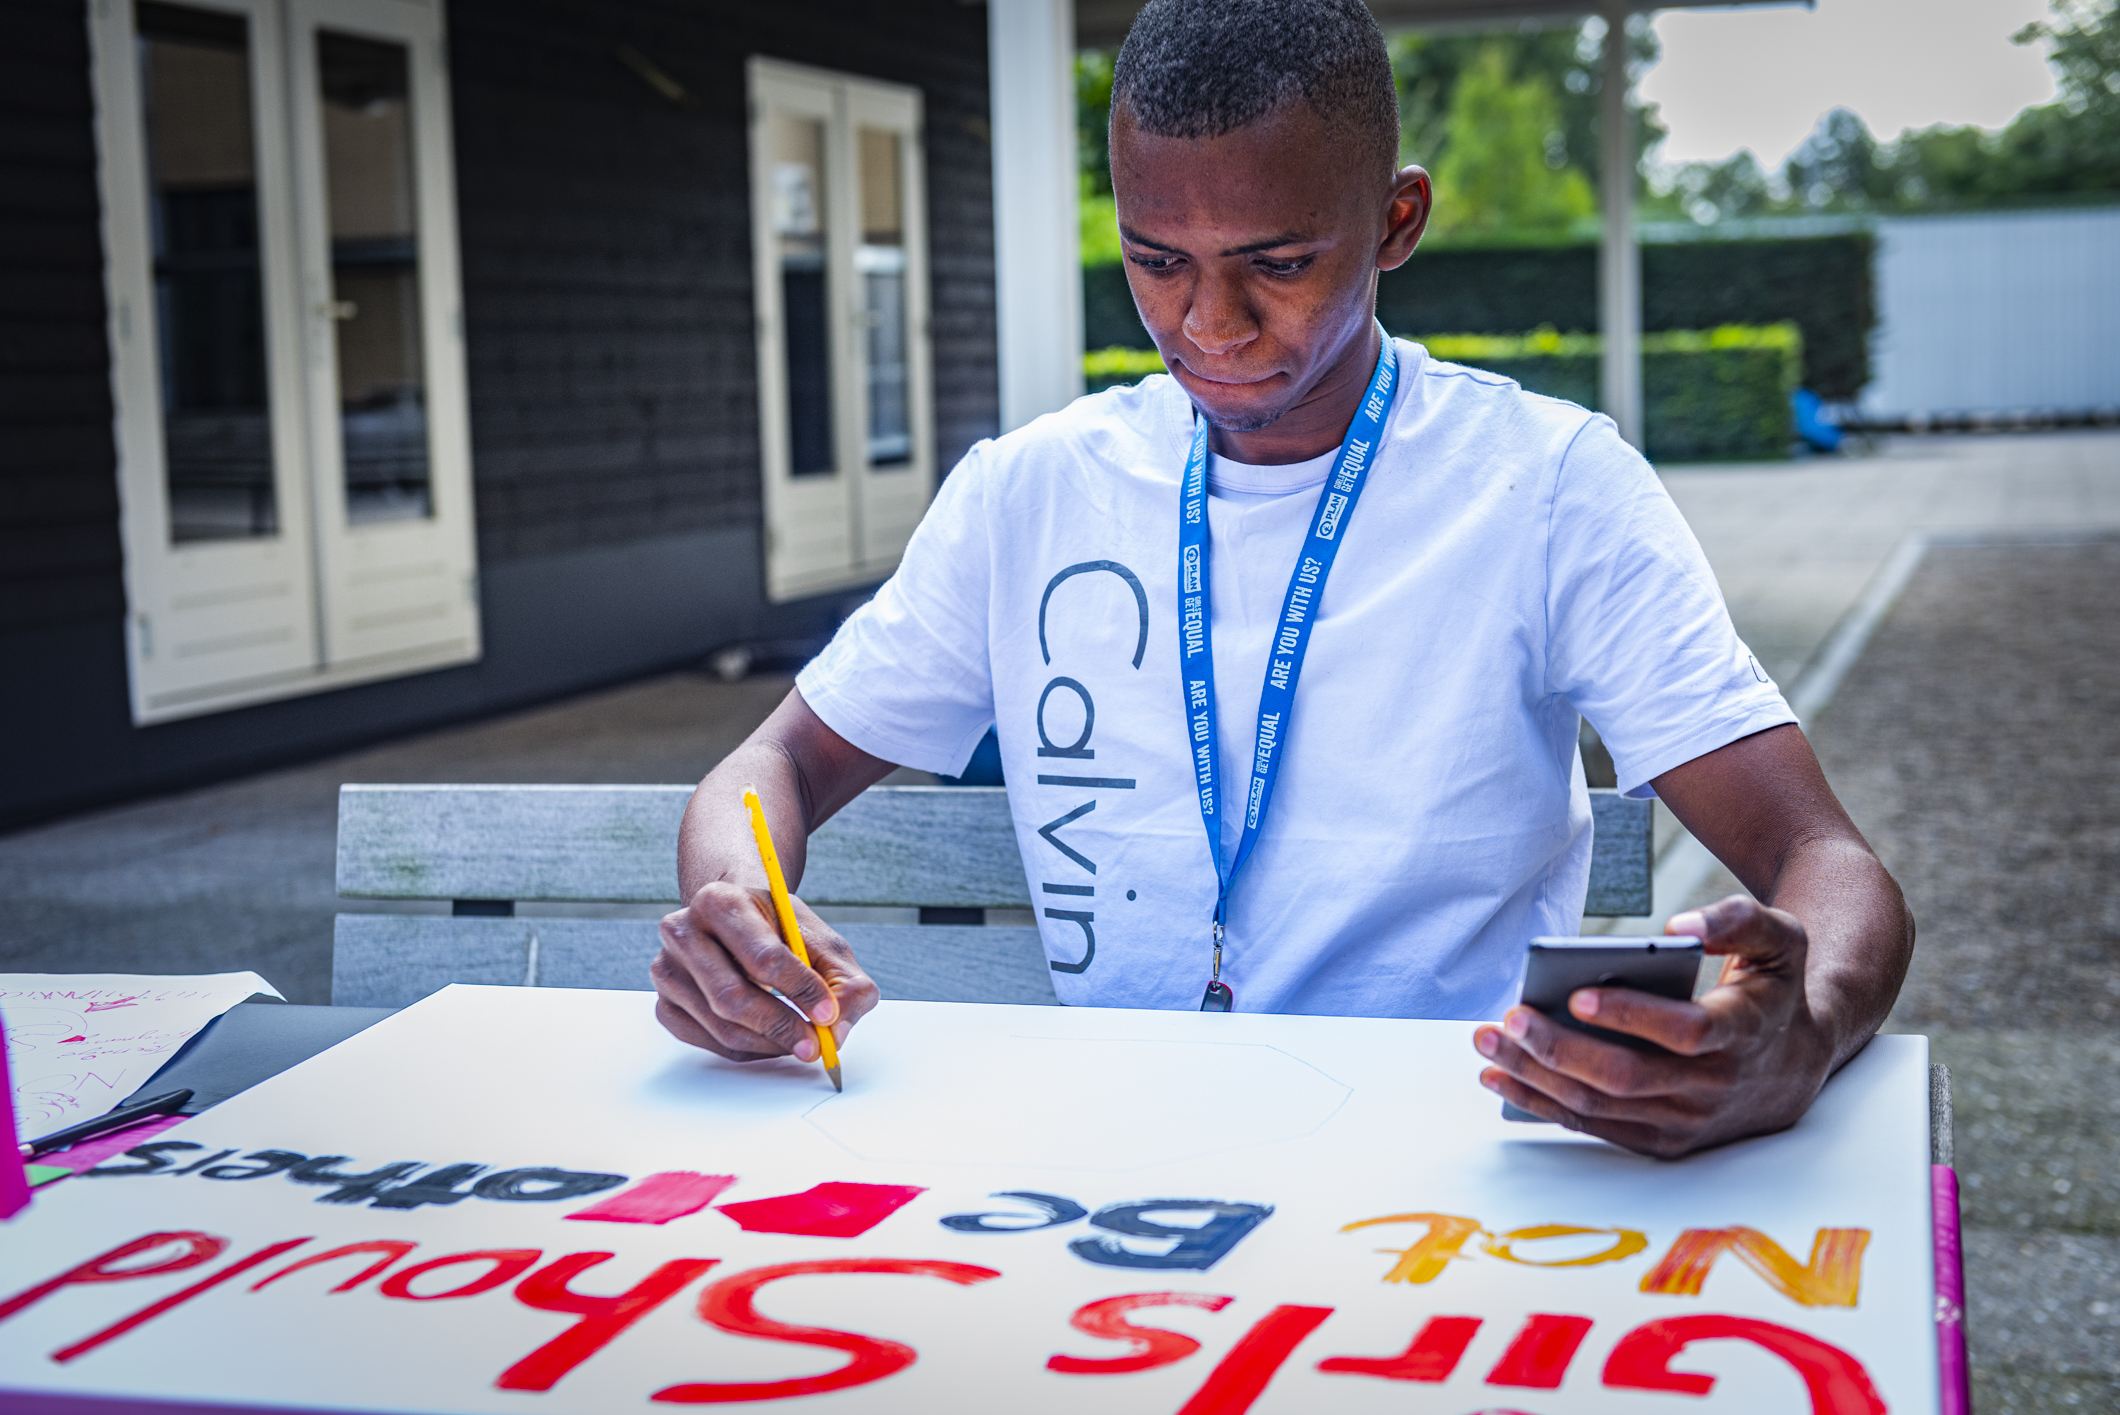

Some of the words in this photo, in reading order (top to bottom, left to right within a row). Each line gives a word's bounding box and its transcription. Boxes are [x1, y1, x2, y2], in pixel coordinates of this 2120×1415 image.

[1364, 392, 1385, 424] ARE
[1375, 366, 1393, 395] YOU
[1192, 434, 1204, 463] YOU
[1339, 438, 1370, 479] EQUAL
[1187, 462, 1202, 498] WITH
[1341, 476, 1356, 493] GET
[1186, 498, 1201, 525] US?
[1325, 495, 1342, 520] PLAN
[1189, 563, 1198, 591] PLAN
[1298, 557, 1322, 584] US?
[1184, 597, 1195, 613] GET
[1285, 585, 1313, 622] WITH
[1183, 612, 1204, 659] EQUAL
[1276, 626, 1300, 655] YOU
[1270, 659, 1292, 690] ARE
[1189, 680, 1208, 710] ARE
[1193, 710, 1209, 742] YOU
[1257, 711, 1280, 758] EQUAL
[1037, 559, 1149, 975] Calvin
[1197, 743, 1212, 785] WITH
[1259, 755, 1270, 774] GET
[1201, 787, 1214, 815] US?
[1251, 779, 1261, 808] PLAN
[938, 1190, 1275, 1270] Be
[1338, 1212, 1872, 1308] Not
[0, 1231, 1002, 1403] Should
[1046, 1291, 1888, 1415] Girls
